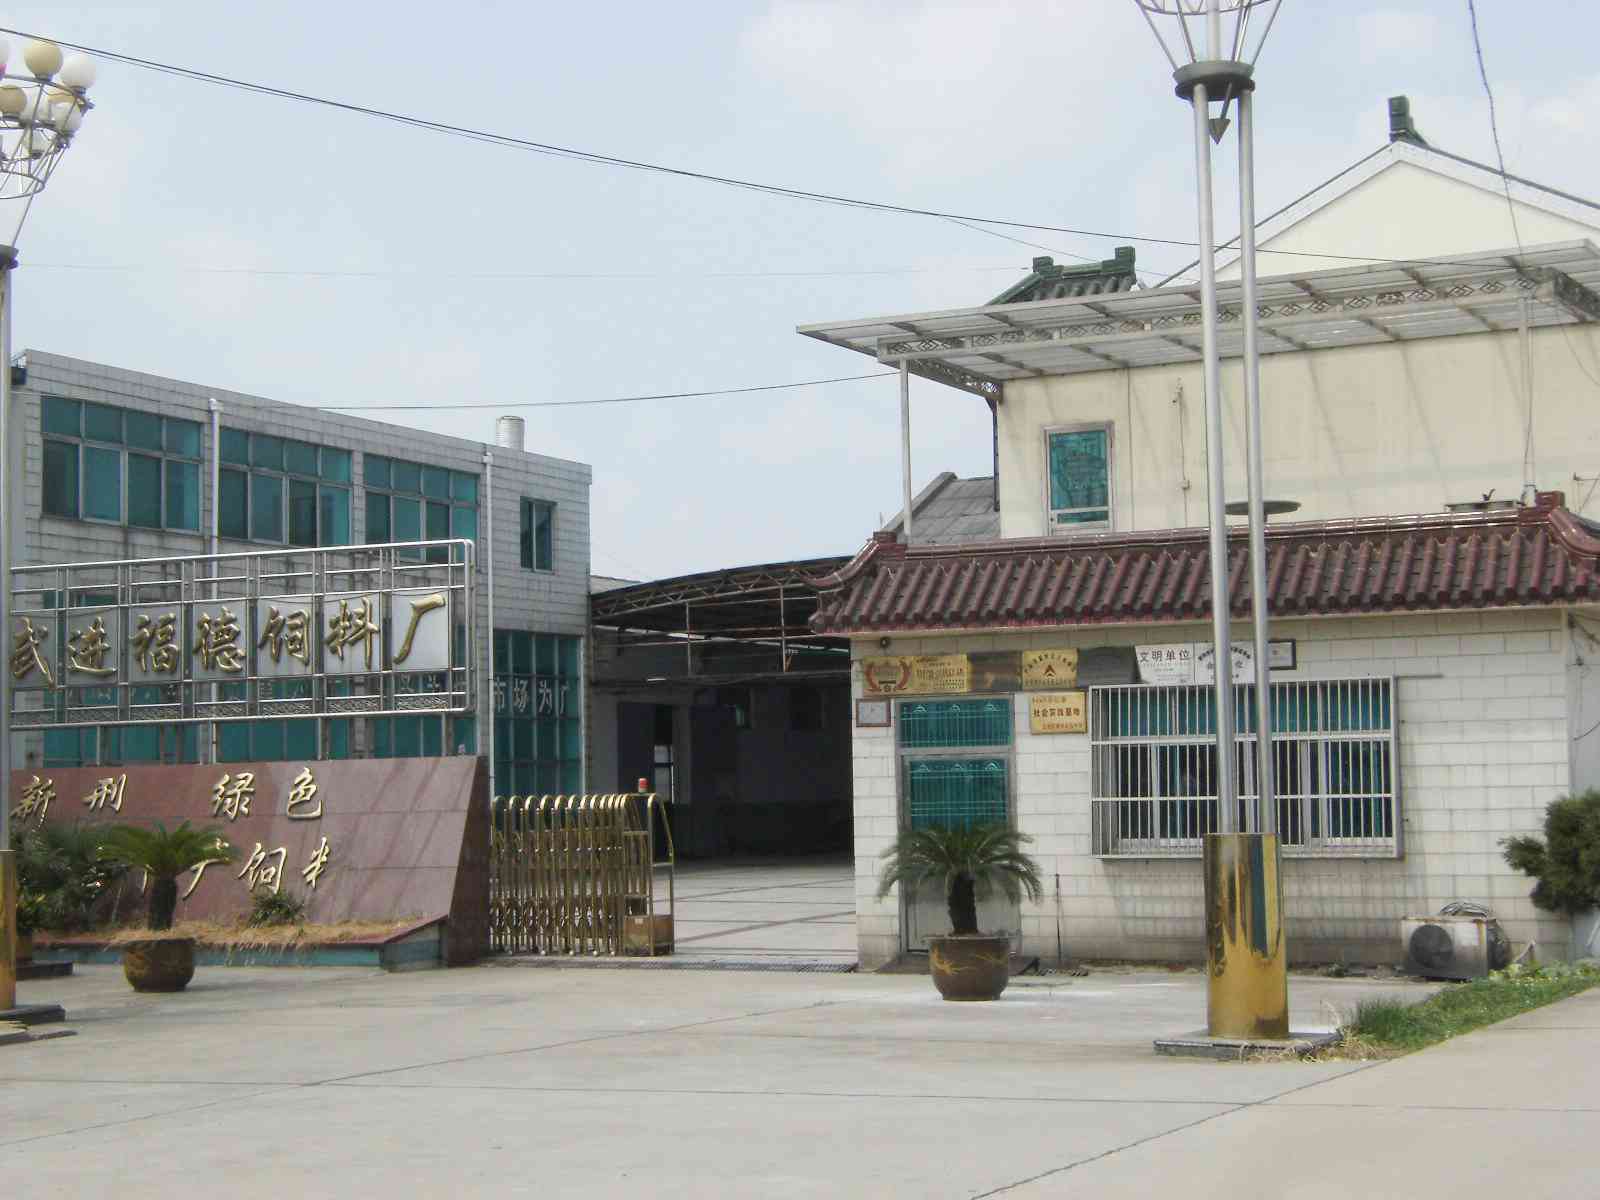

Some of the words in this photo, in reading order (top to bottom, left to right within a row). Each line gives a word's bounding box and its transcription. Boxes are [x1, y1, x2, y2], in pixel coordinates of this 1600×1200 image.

[11, 594, 446, 689] 武进福德饲料厂
[1139, 648, 1193, 662] 文明单位
[212, 767, 324, 820] 绿色
